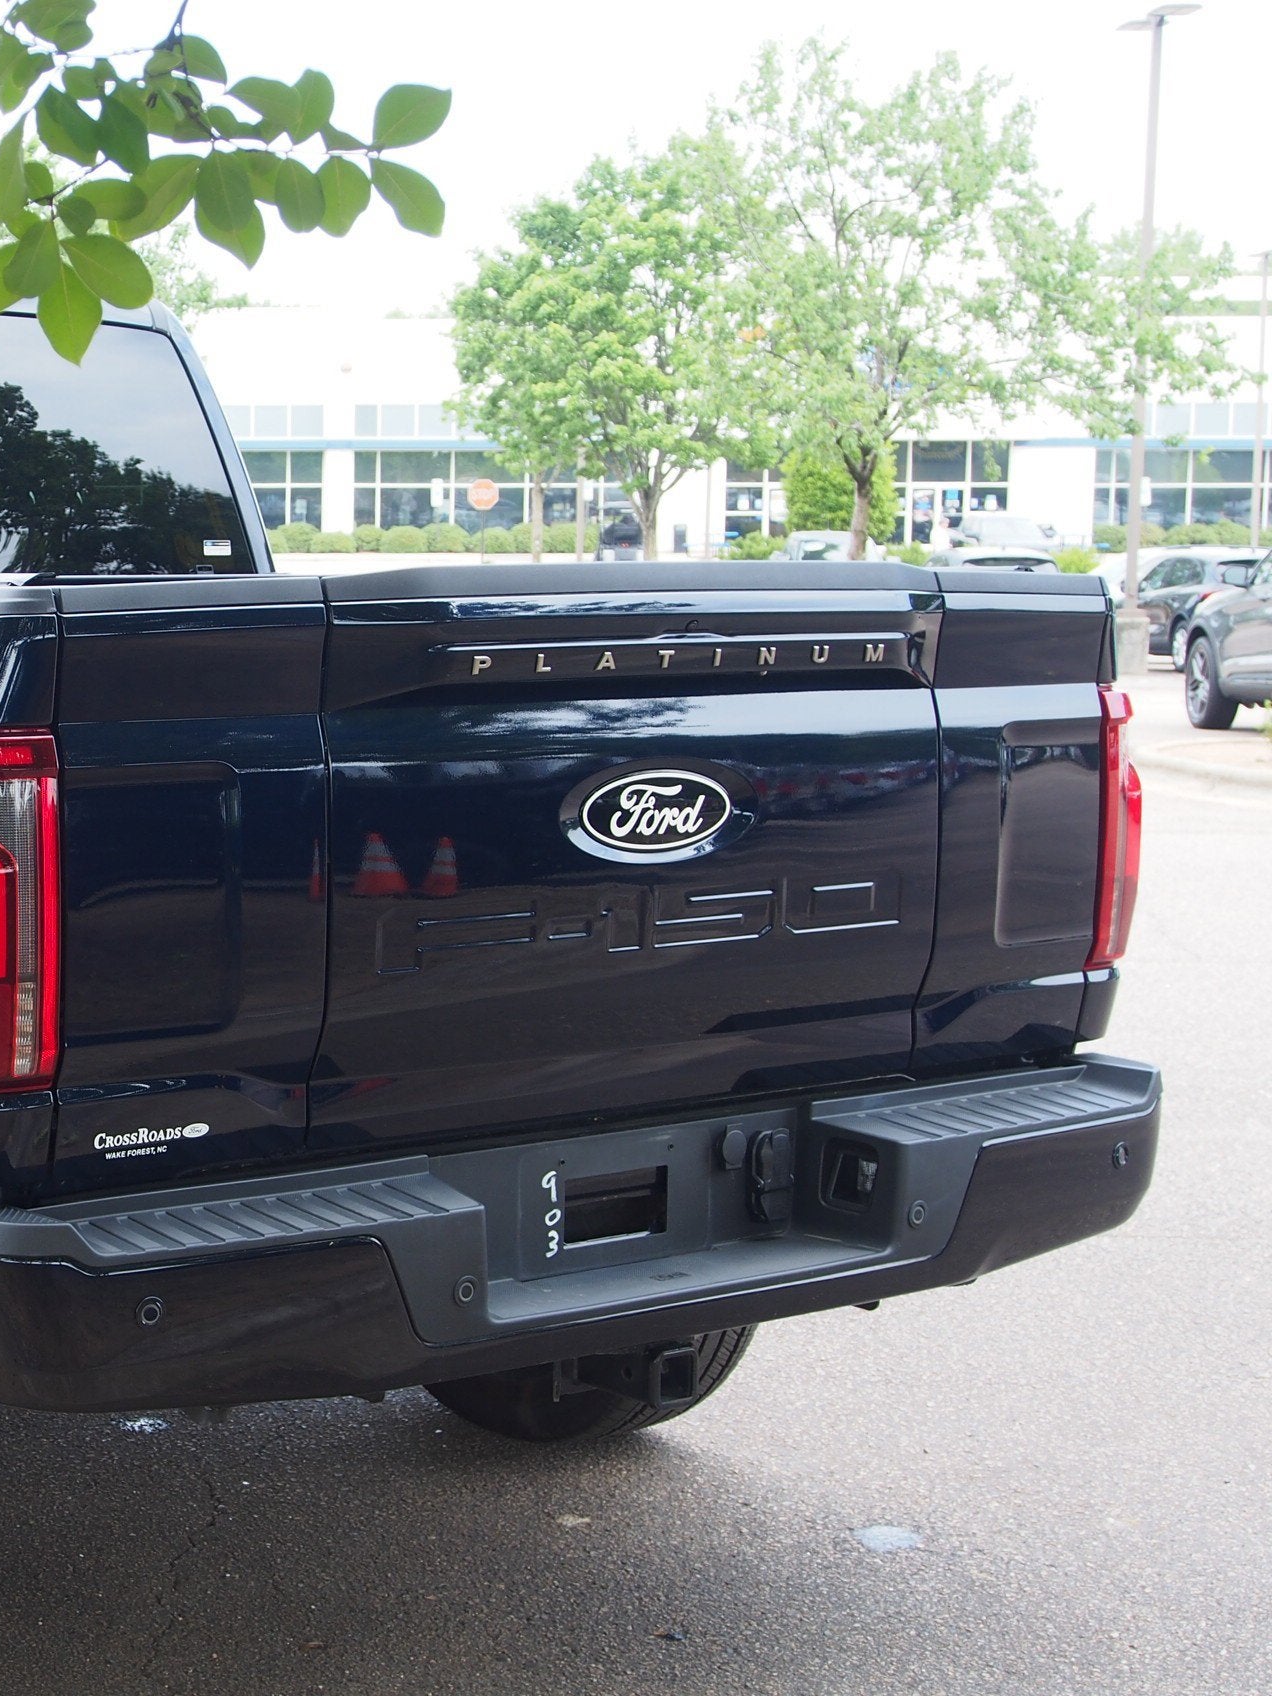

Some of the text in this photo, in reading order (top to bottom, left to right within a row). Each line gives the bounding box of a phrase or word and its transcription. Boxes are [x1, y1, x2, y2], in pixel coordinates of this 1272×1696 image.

[472, 643, 886, 676] PLATINUM
[609, 783, 706, 838] Ford
[376, 874, 901, 974] F-150
[105, 1145, 168, 1160] WAKE FOREST, NC
